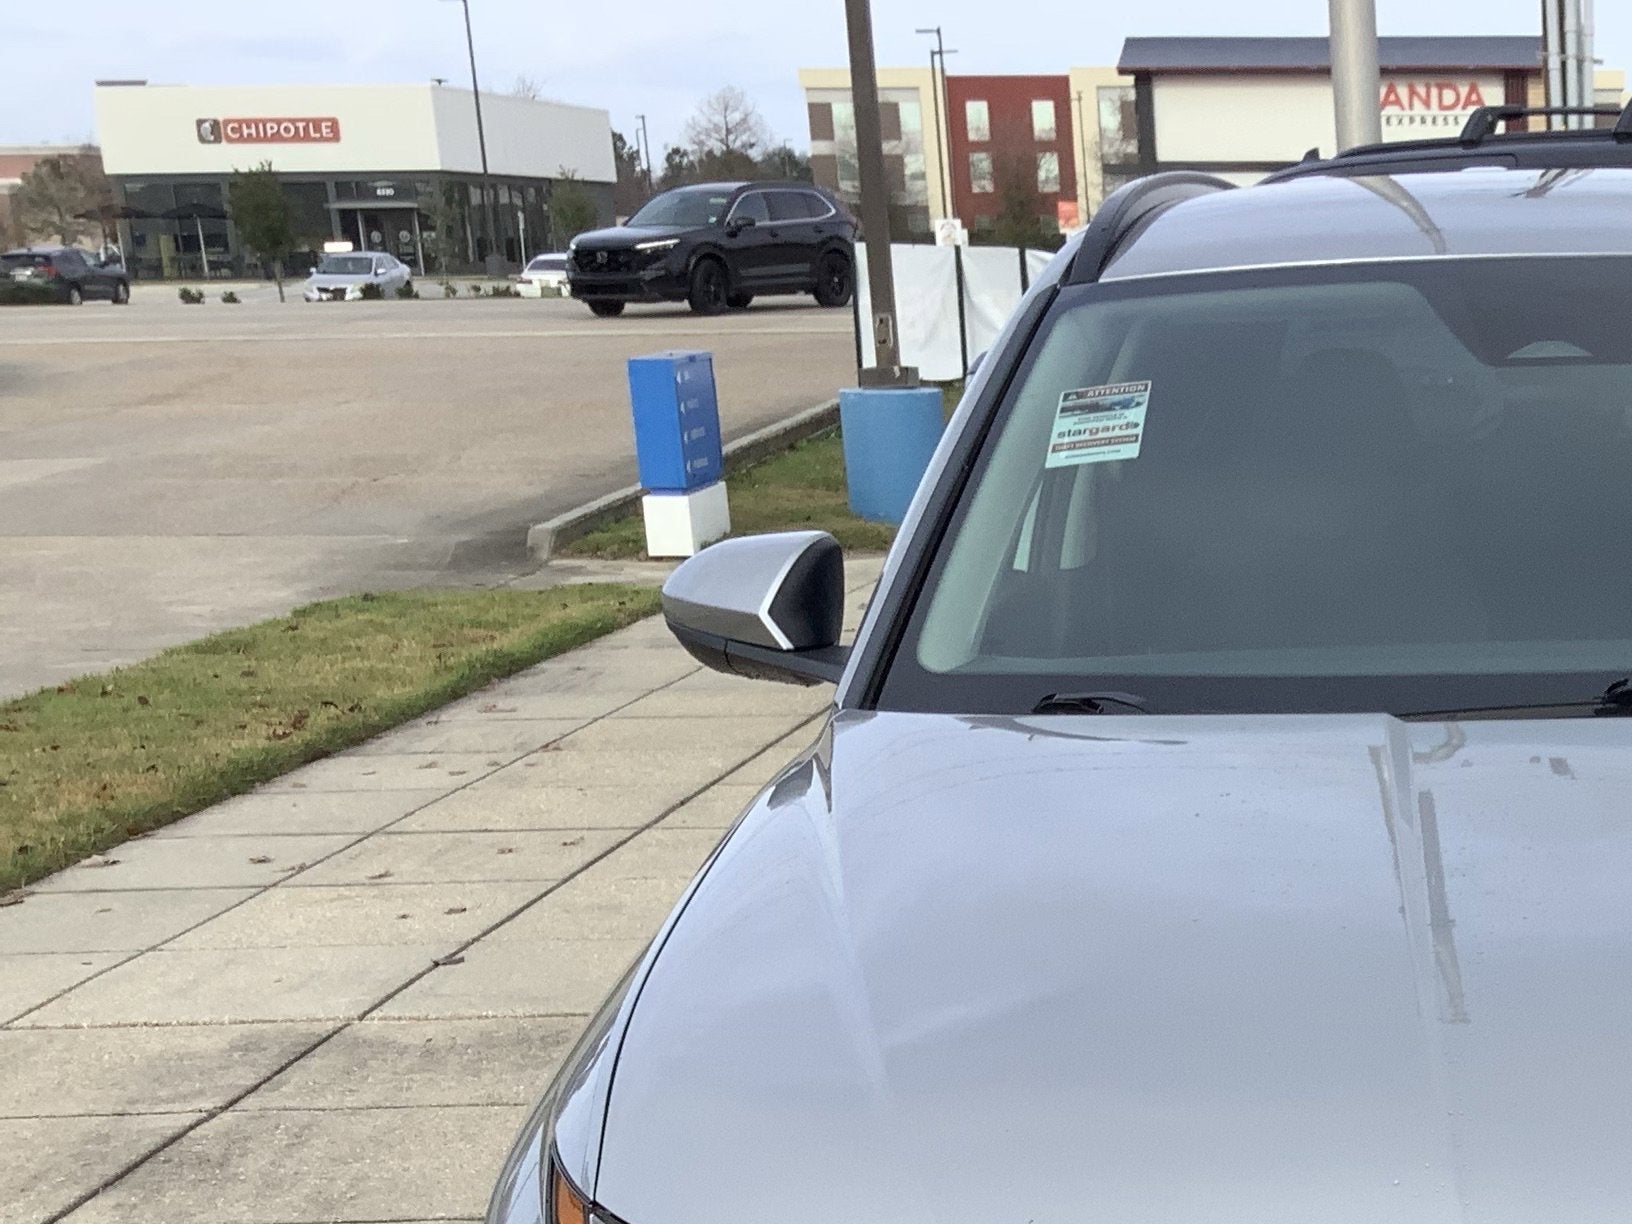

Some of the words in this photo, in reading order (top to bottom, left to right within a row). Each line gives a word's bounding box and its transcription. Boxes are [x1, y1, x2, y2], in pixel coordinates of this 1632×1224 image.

[1380, 81, 1486, 111] ANDA
[1386, 115, 1460, 126] EXPRESS
[226, 122, 334, 138] CHIPOTLE
[1087, 384, 1146, 397] ATTENTION
